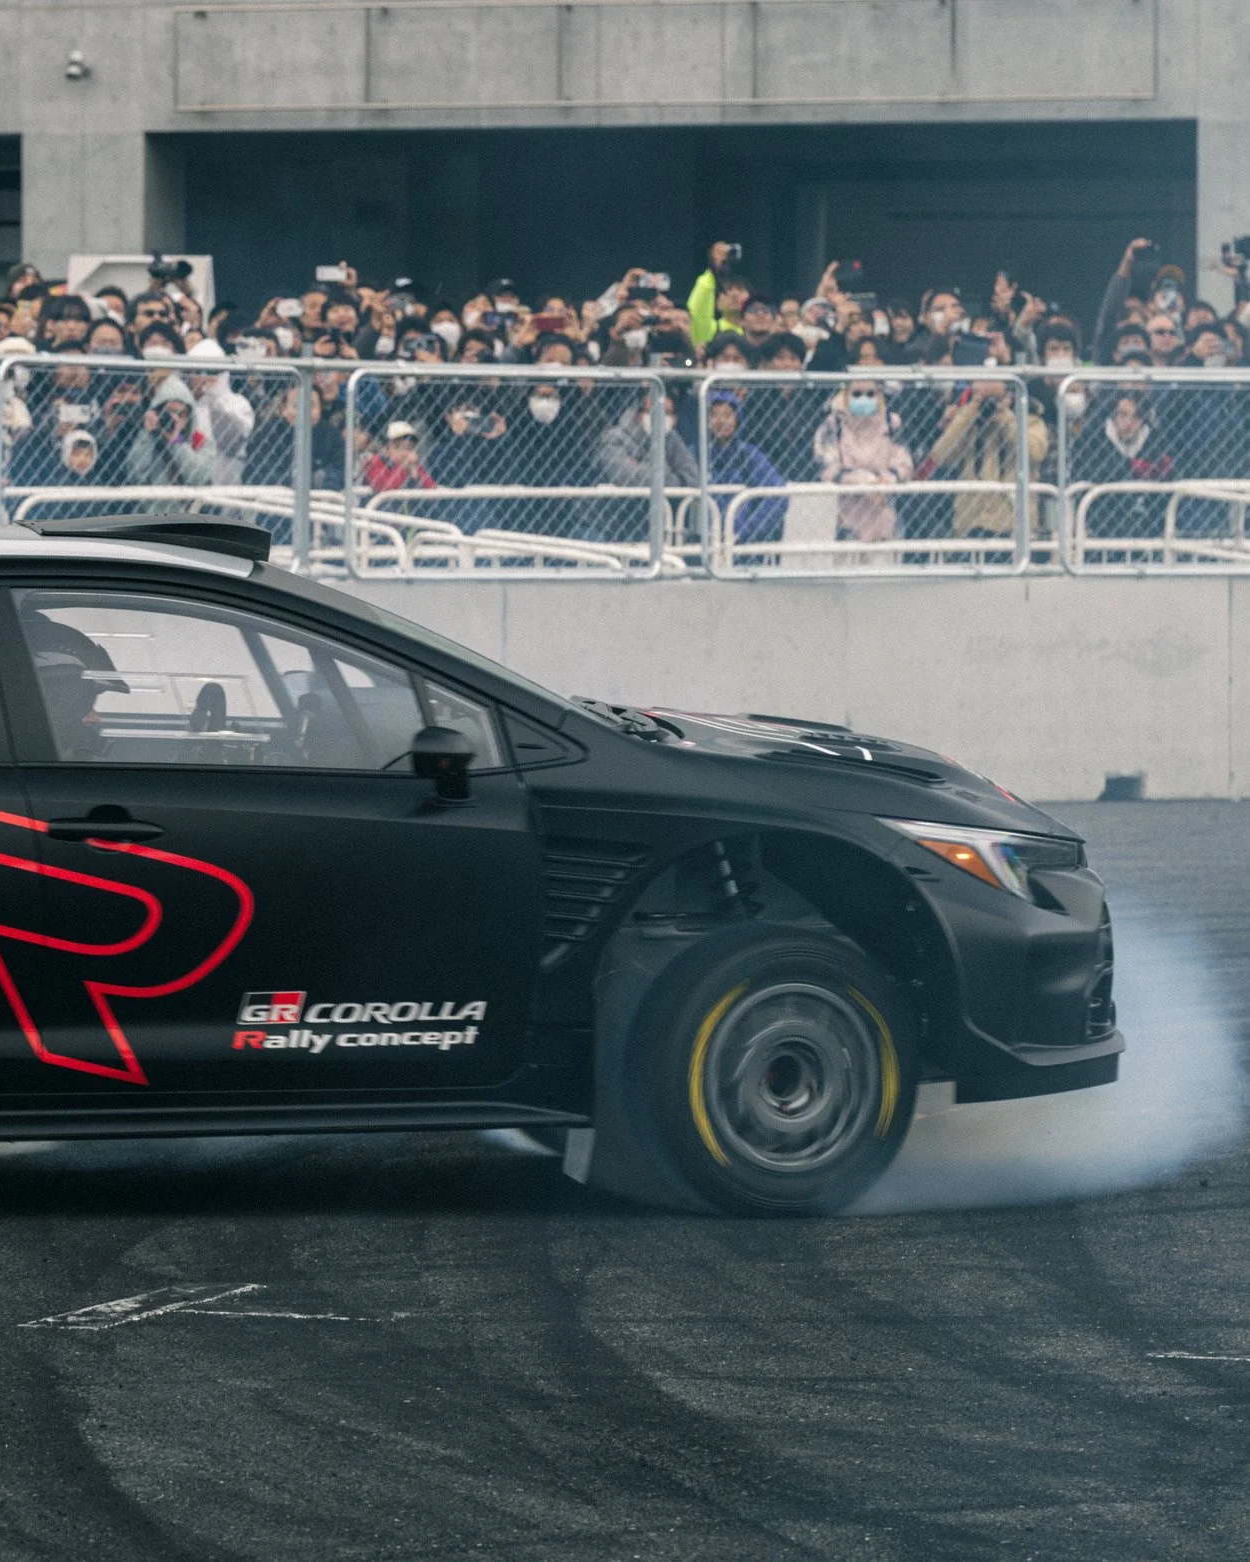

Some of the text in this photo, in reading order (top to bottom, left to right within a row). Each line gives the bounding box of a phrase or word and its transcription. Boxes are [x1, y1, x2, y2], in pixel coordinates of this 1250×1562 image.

[240, 1001, 488, 1024] GR COROLLA
[232, 1026, 480, 1054] Rally concept
